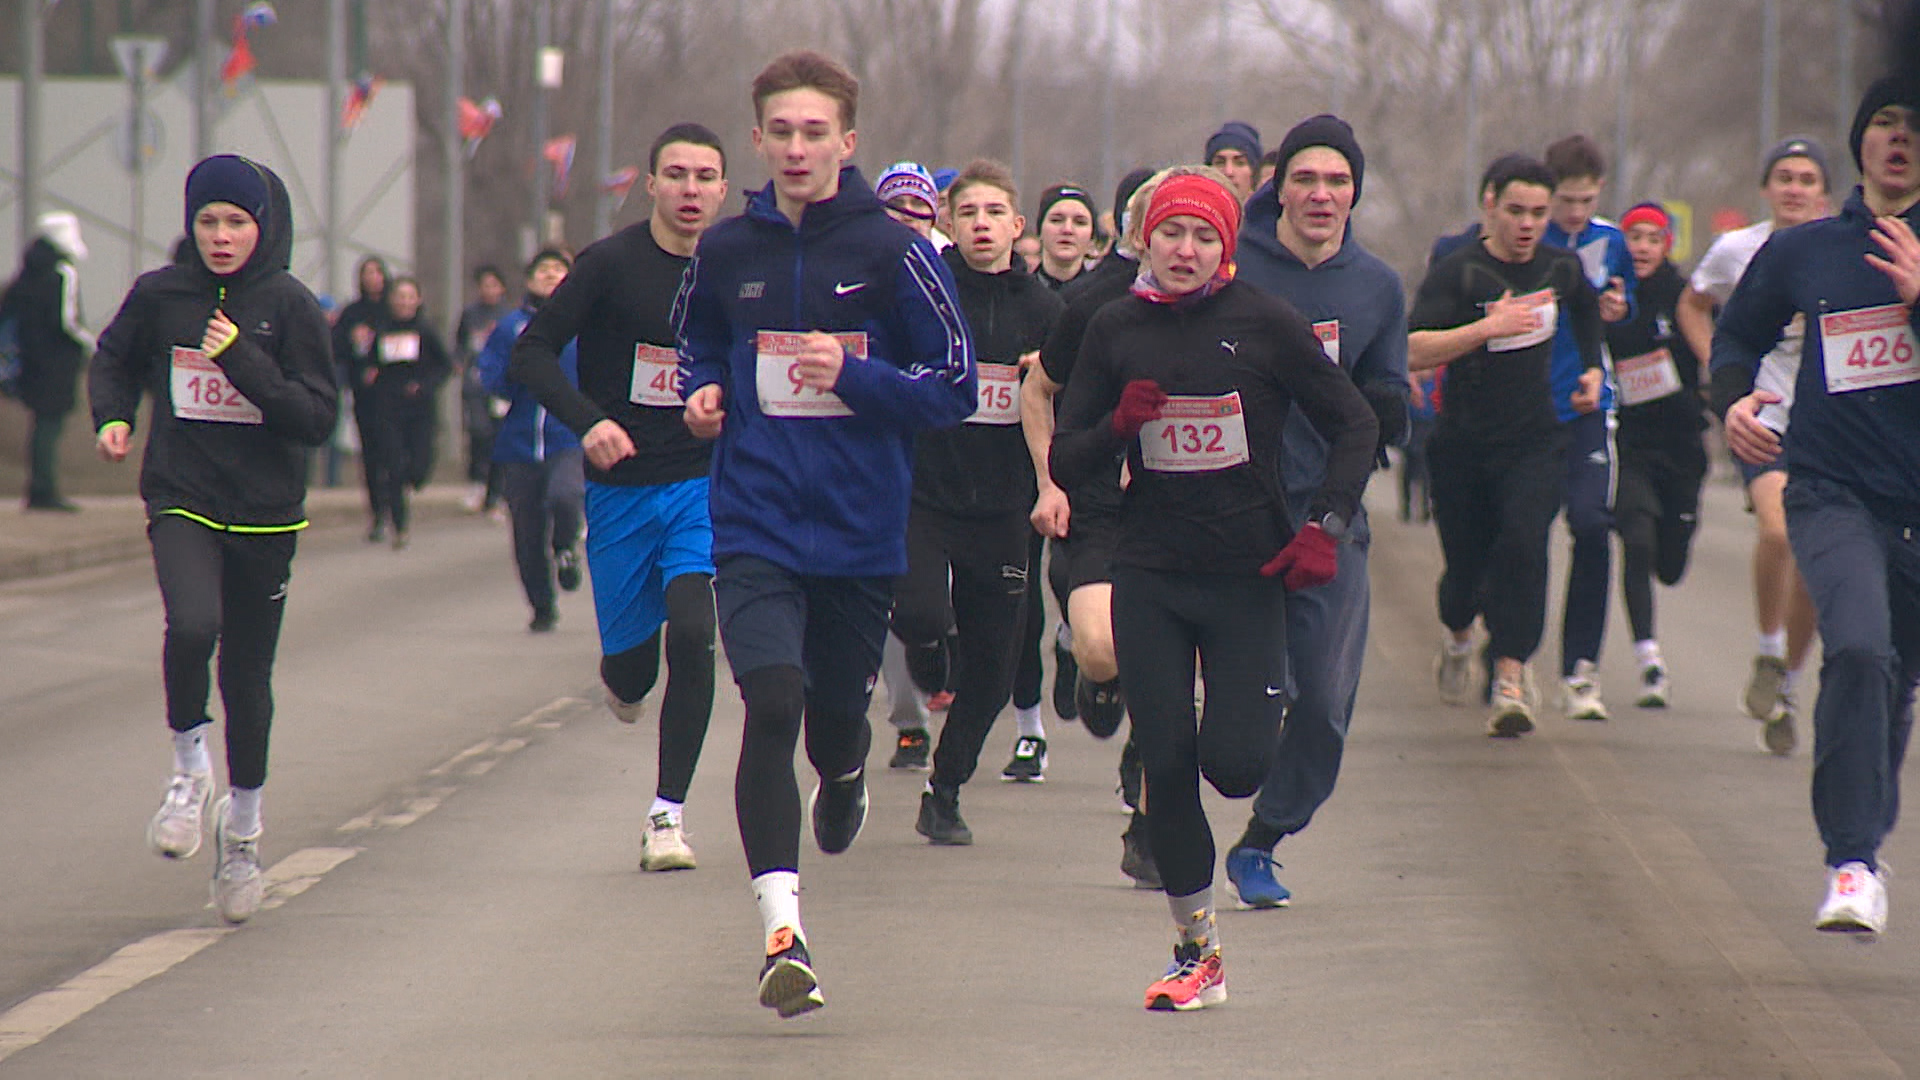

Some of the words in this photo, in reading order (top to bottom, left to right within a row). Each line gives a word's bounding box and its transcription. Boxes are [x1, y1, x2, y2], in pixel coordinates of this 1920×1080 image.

[1846, 333, 1913, 368] 426
[187, 375, 241, 406] 182
[1161, 424, 1225, 453] 132
